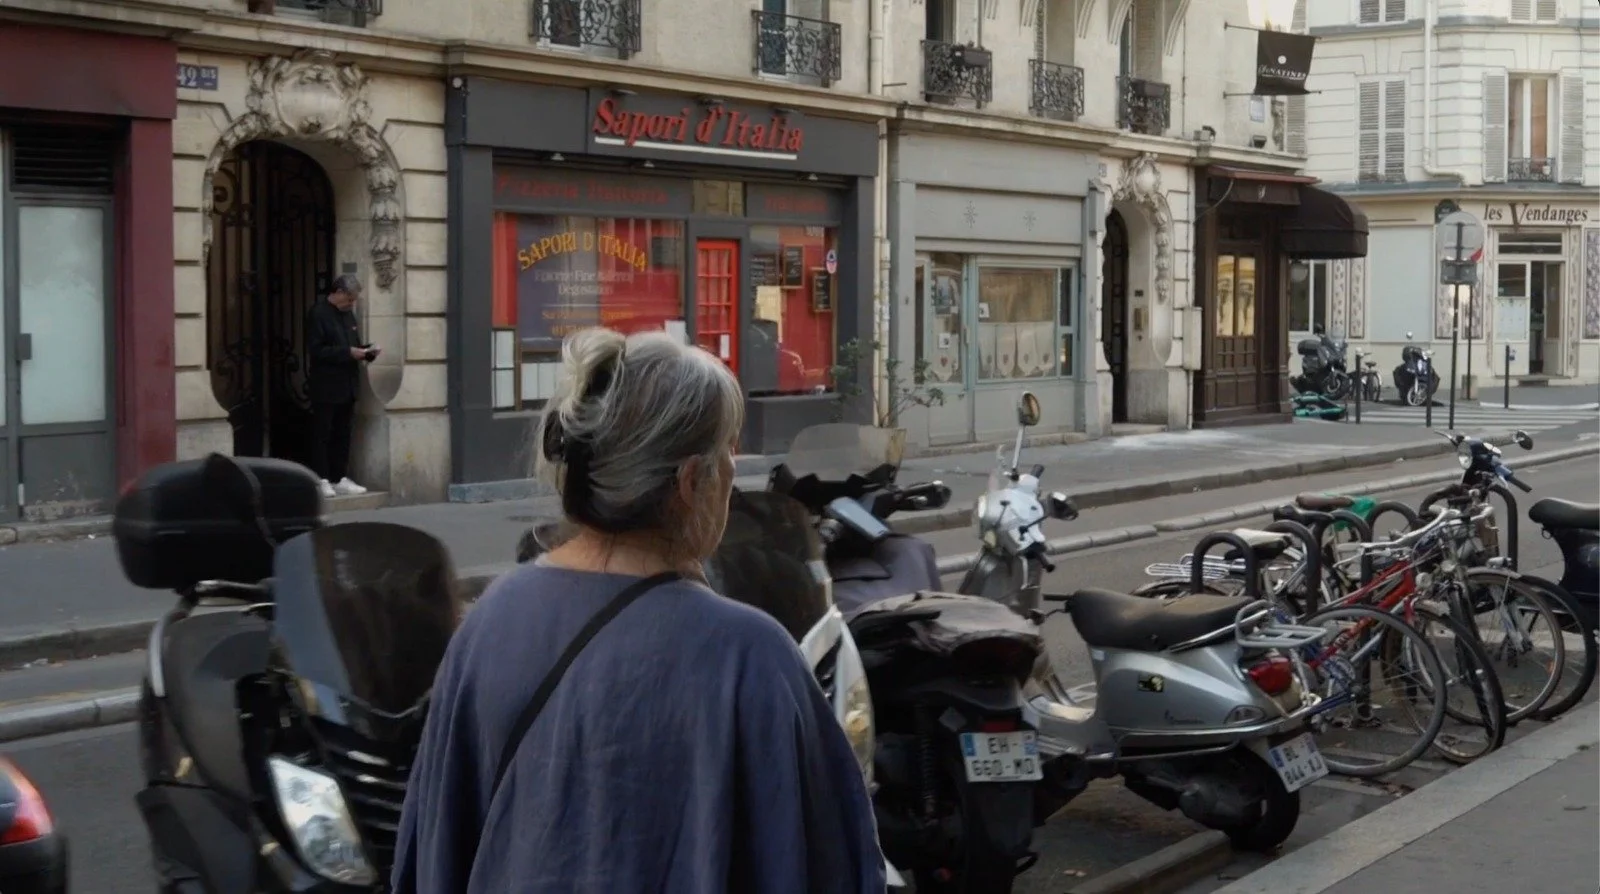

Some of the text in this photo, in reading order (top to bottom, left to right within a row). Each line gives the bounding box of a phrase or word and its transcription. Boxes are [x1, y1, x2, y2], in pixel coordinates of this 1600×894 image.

[593, 97, 804, 152] Sapori d'Italia
[1484, 203, 1588, 232] les Vendanges
[518, 231, 577, 271] SAPORI
